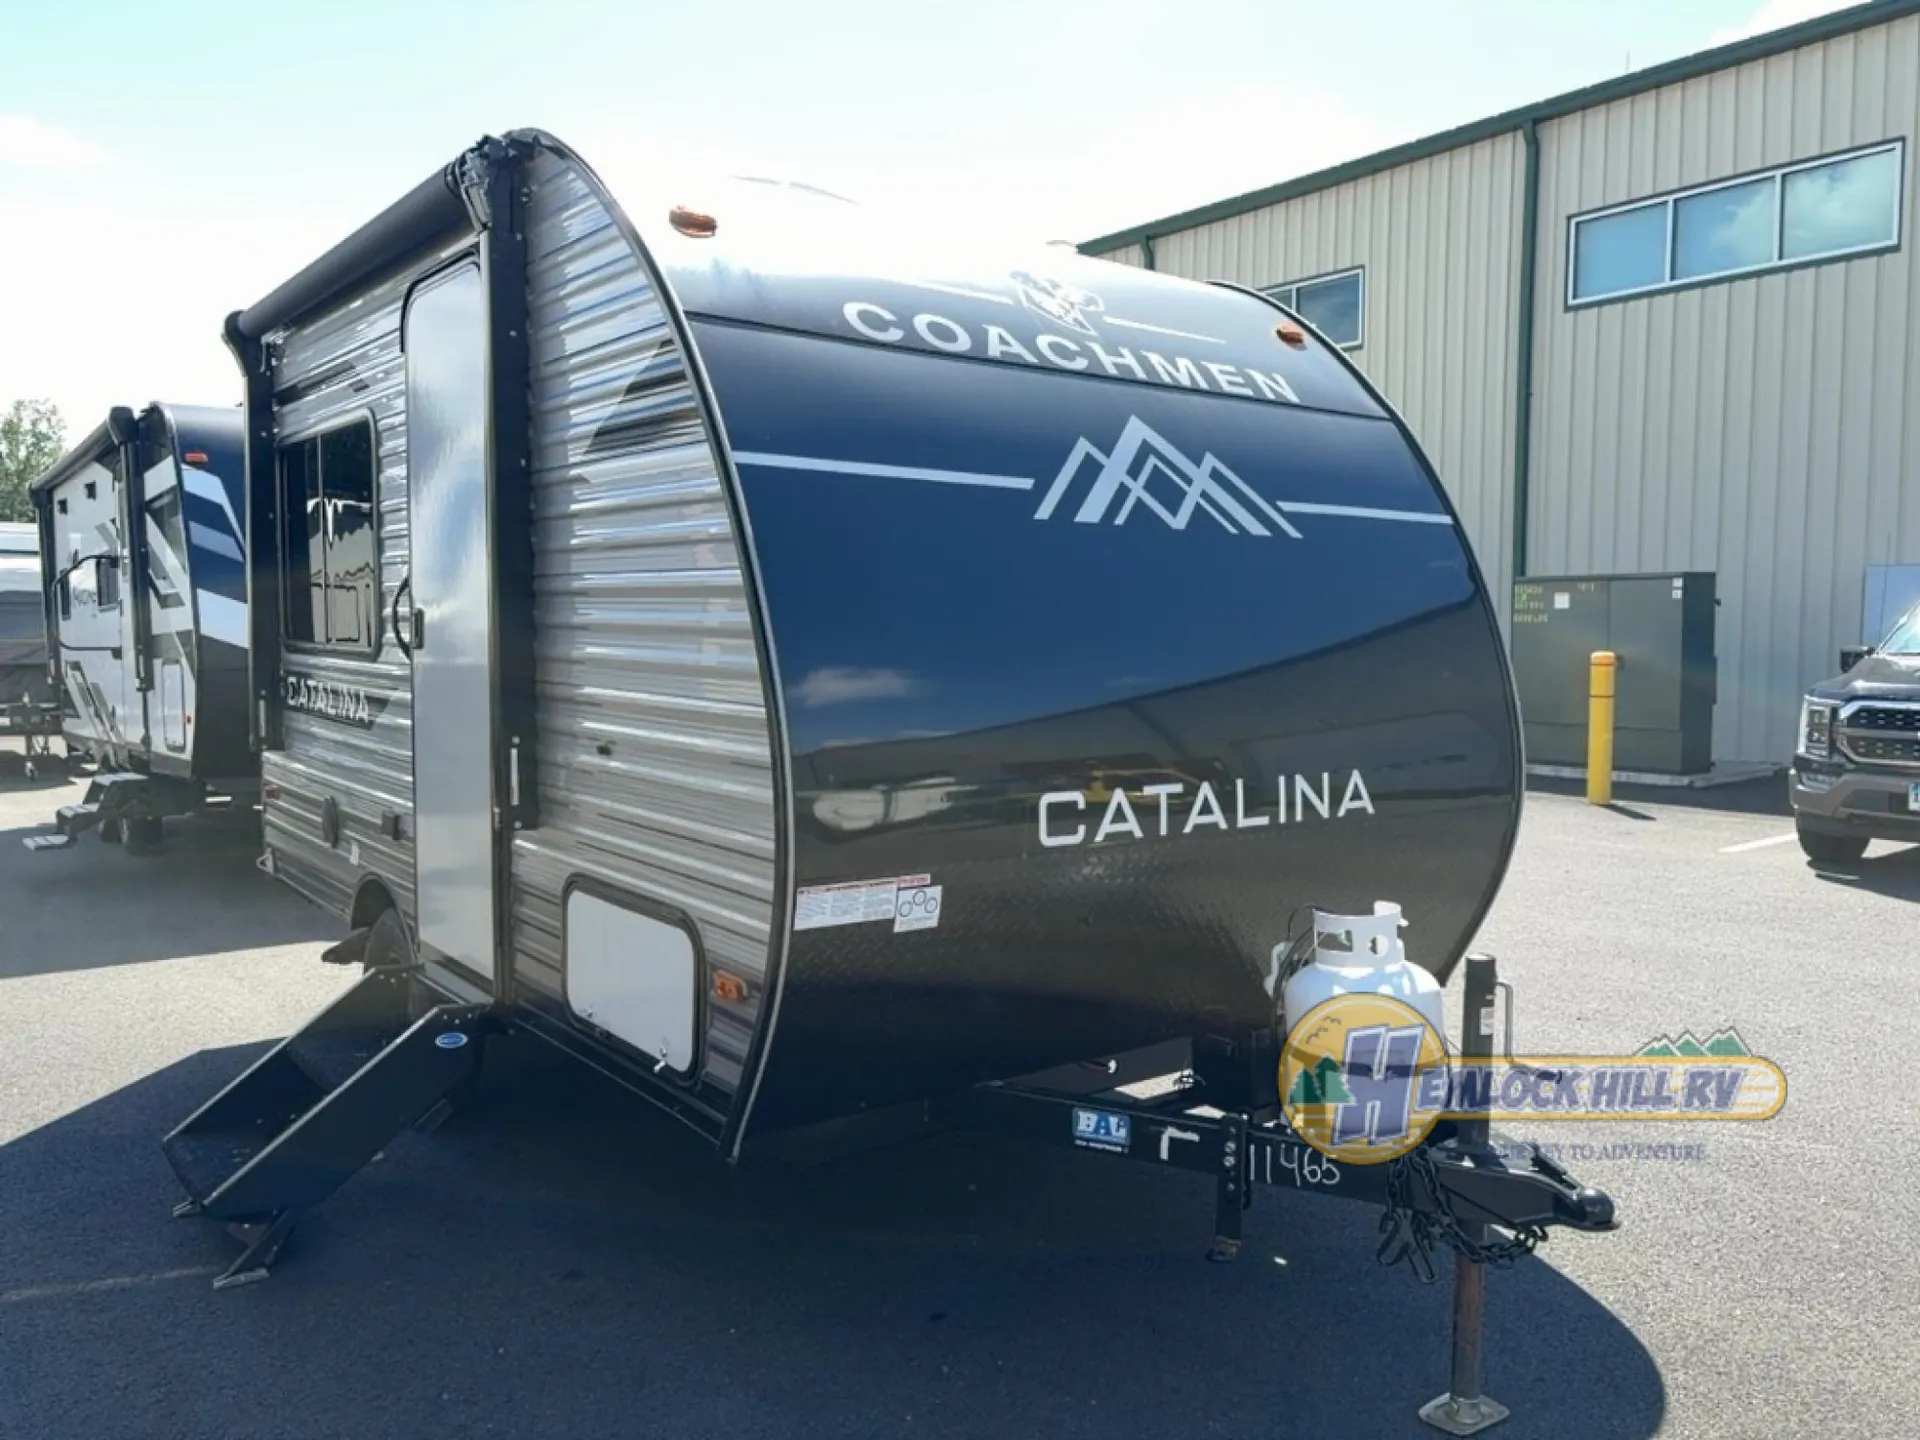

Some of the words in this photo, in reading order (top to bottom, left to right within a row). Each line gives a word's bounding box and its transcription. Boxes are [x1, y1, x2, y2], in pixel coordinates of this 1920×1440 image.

[842, 301, 1300, 404] COACHMEN
[286, 676, 369, 723] CATALINA
[1038, 768, 1376, 848] CATALINA
[1249, 1143, 1341, 1188] 11465
